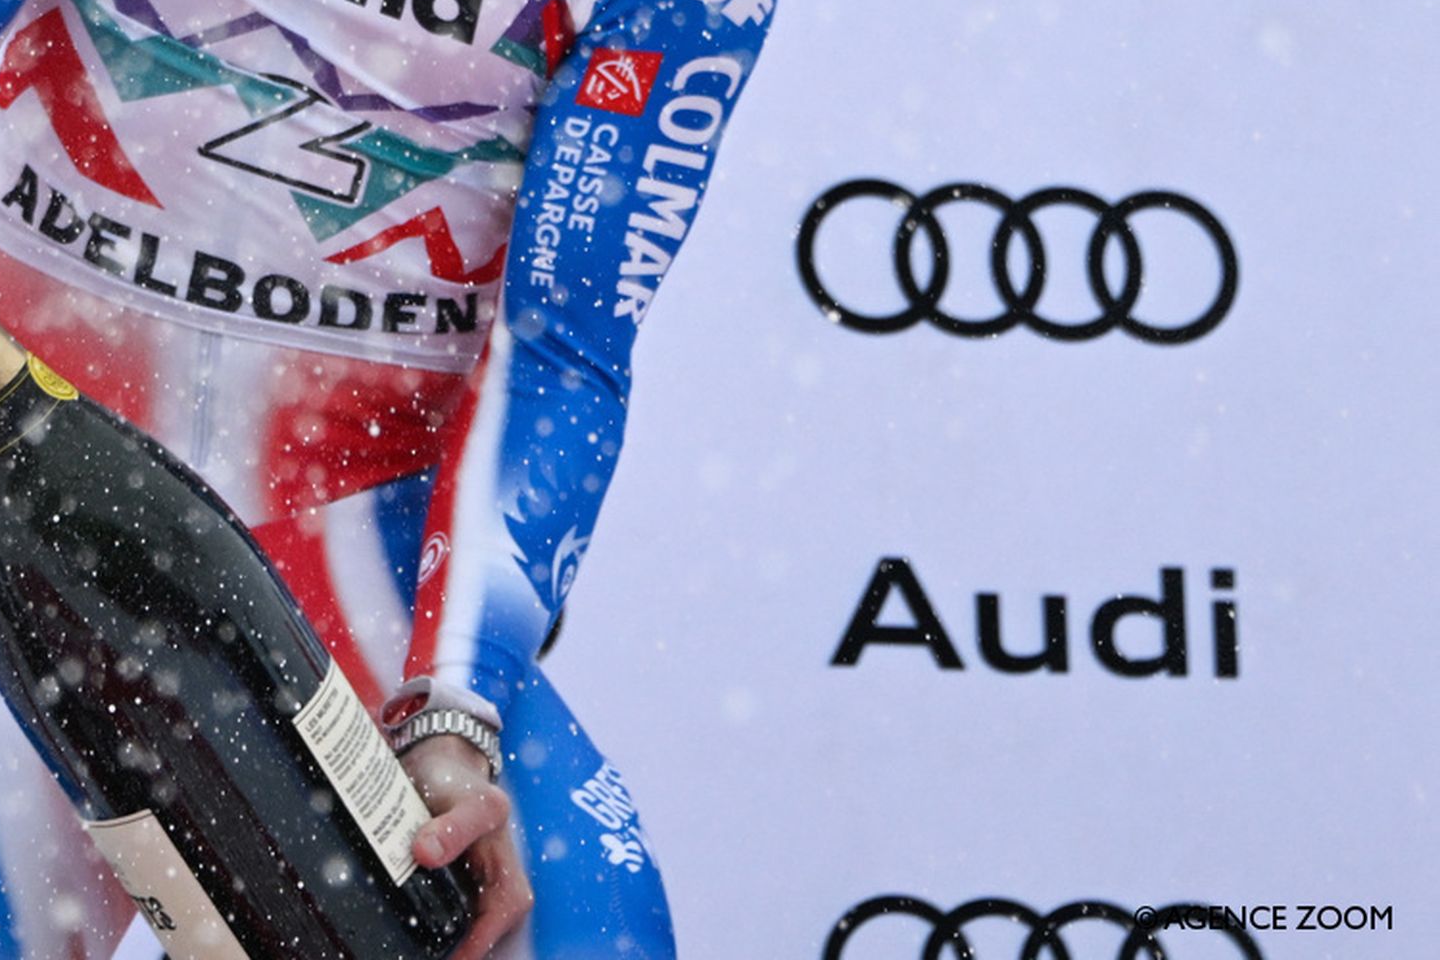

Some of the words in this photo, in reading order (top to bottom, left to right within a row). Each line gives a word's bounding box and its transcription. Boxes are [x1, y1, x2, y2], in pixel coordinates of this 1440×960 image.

[2, 163, 478, 335] ADELBODEN
[530, 116, 592, 289] D'EPARGNE
[568, 124, 618, 233] CAISSE
[613, 55, 745, 326] COLMAR
[828, 556, 1240, 679] Audi
